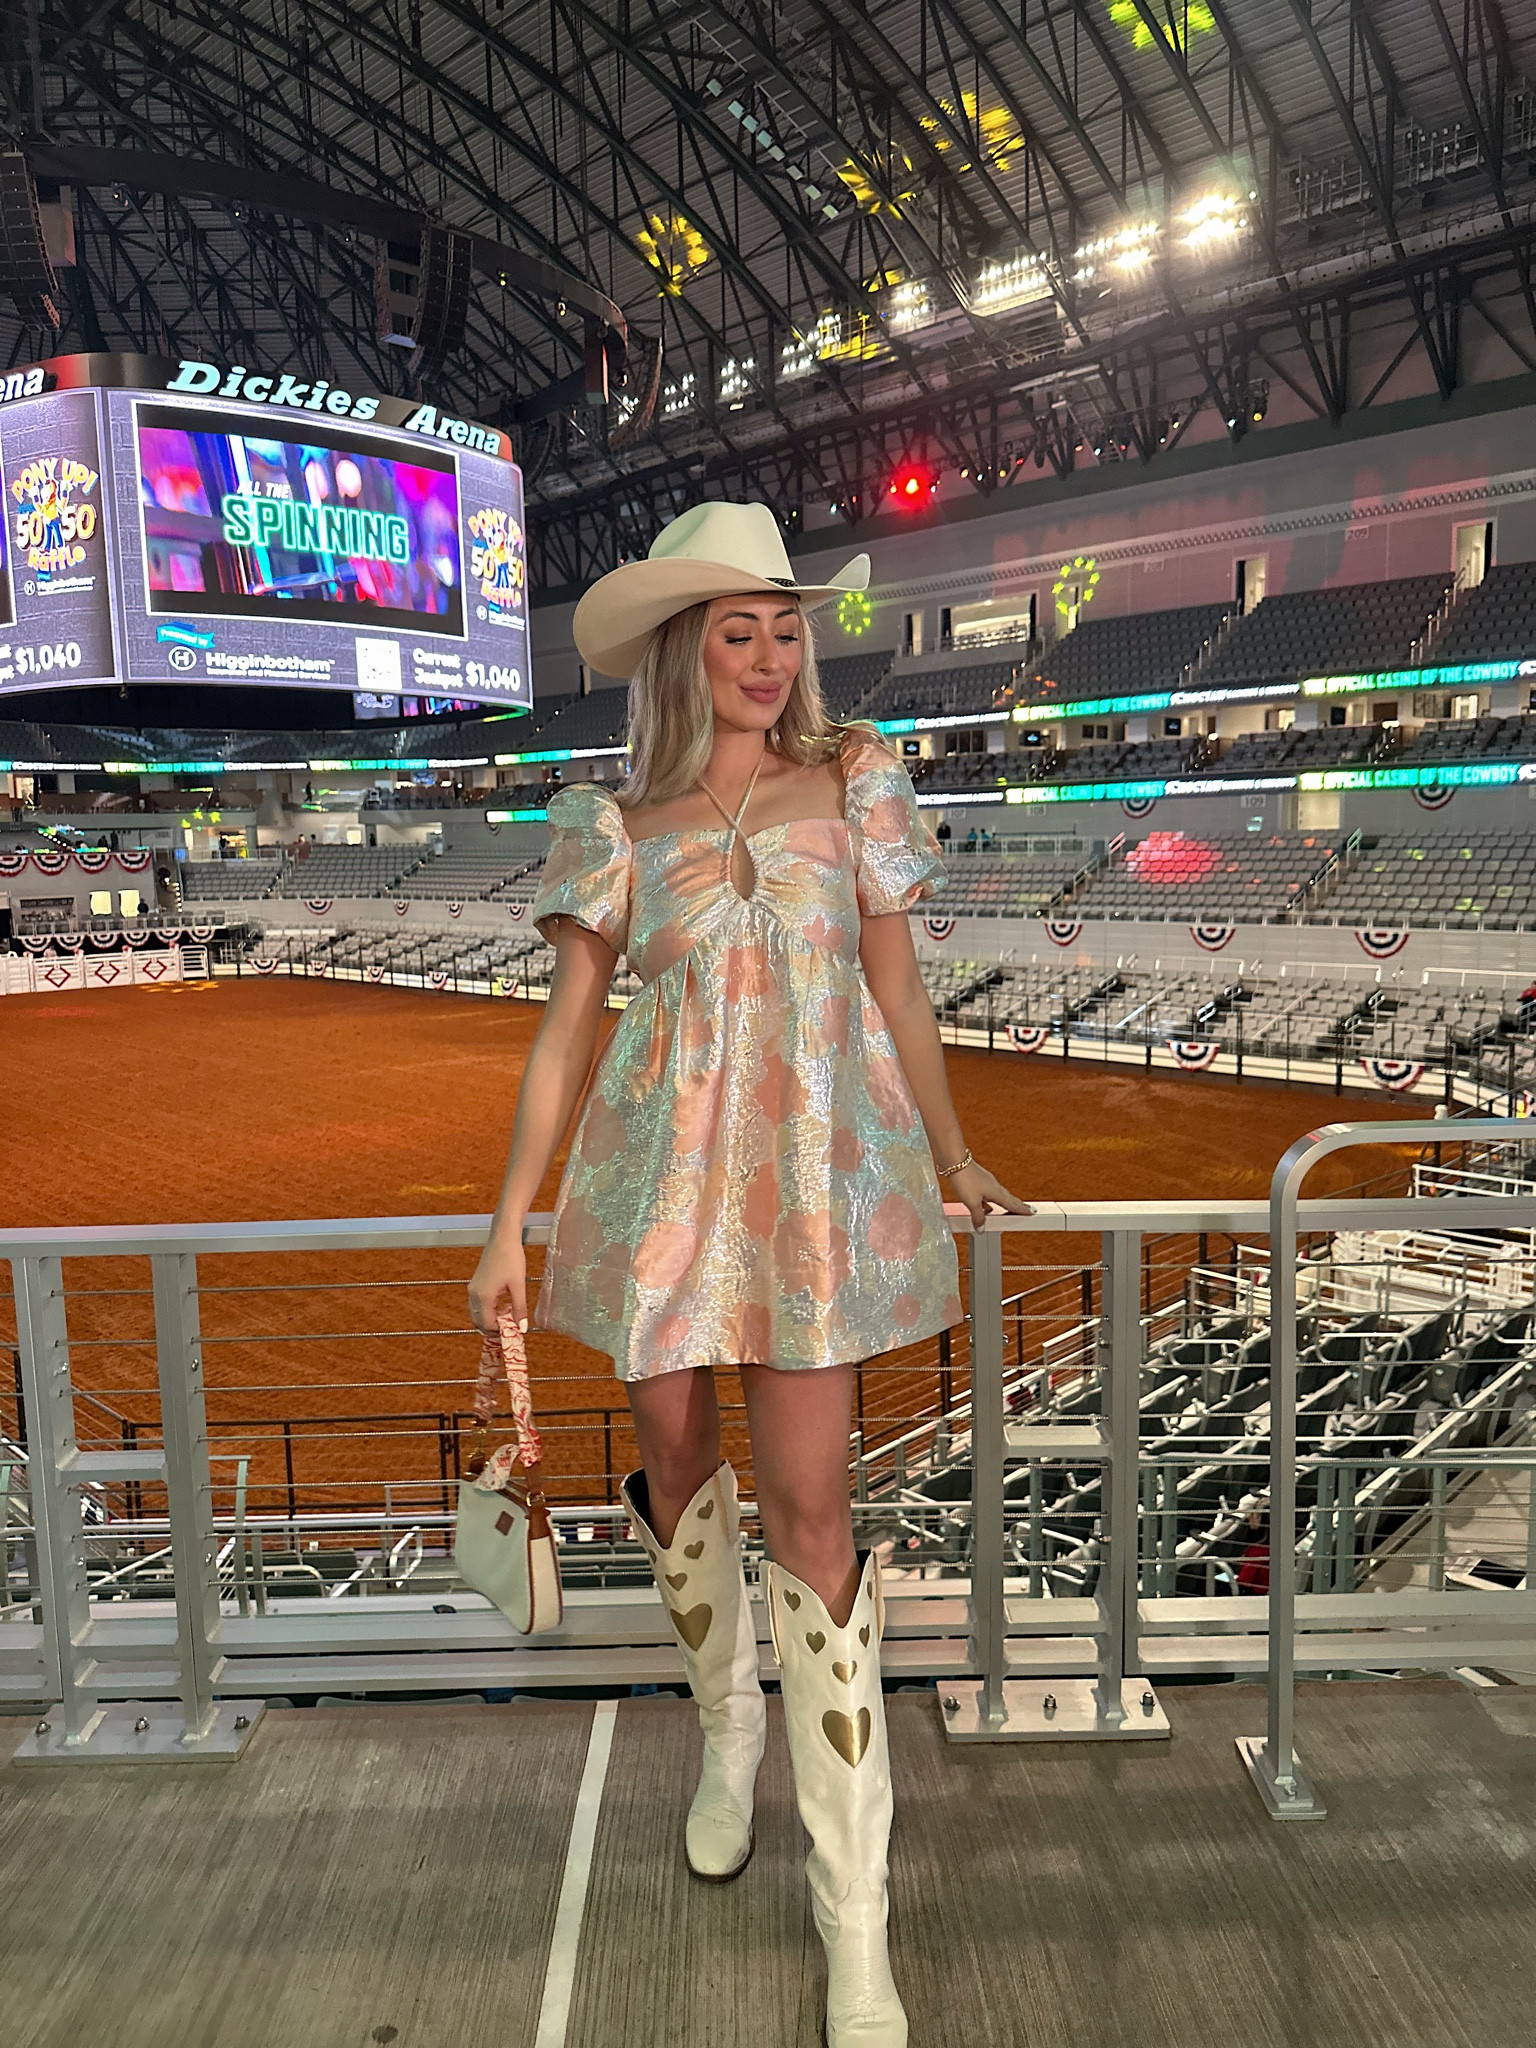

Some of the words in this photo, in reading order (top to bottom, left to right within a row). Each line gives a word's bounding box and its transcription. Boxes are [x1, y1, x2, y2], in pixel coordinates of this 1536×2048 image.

[167, 360, 381, 420] Dickies
[405, 404, 500, 455] Arena
[11, 457, 59, 503] PONY
[16, 512, 43, 550] 50
[61, 504, 96, 541] 50
[222, 494, 411, 565] SPINNING
[468, 508, 507, 538] PONY
[28, 545, 87, 572] Raffle
[471, 546, 495, 580] 50
[15, 642, 82, 675] $1,040
[1377, 669, 1420, 689] CASINO
[1421, 668, 1438, 684] OF
[1438, 666, 1463, 683] THE
[1463, 661, 1520, 681] COWBOY
[465, 660, 521, 692] $1,040
[1374, 769, 1419, 787] CASINO
[1438, 766, 1463, 784] THE
[1463, 764, 1520, 783] COWBOY
